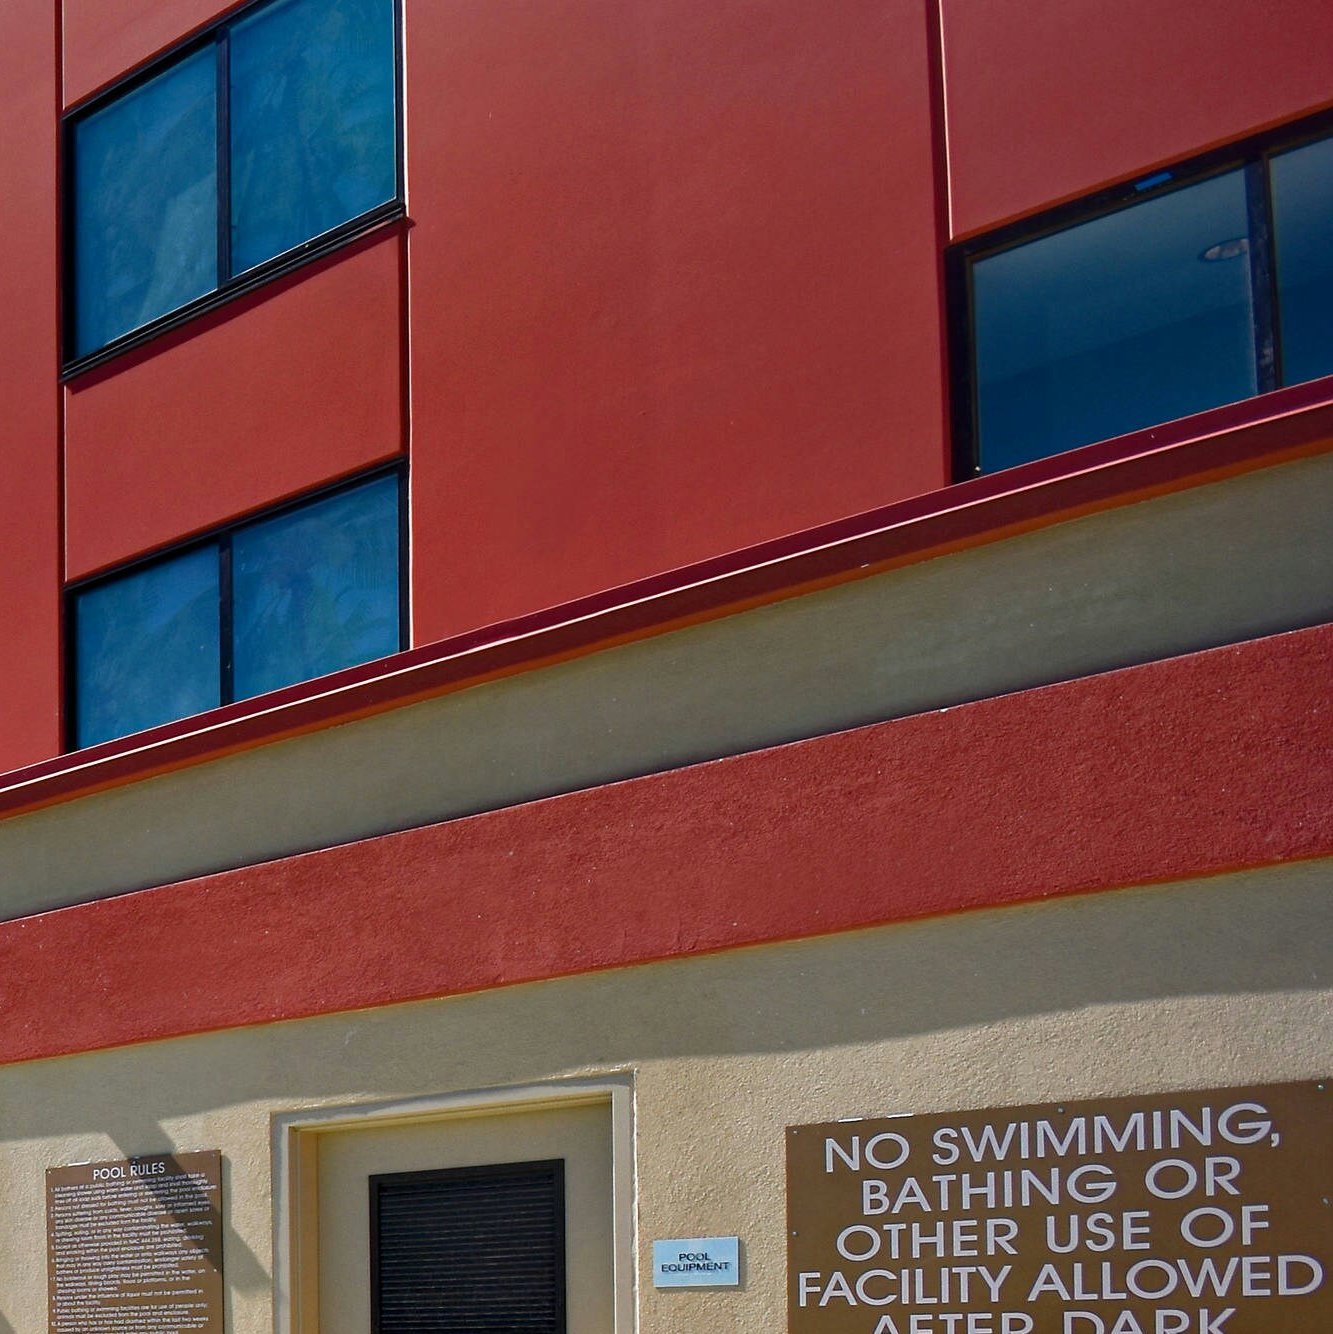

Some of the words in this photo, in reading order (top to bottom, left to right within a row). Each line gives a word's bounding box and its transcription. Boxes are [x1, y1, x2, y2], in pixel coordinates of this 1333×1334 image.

[825, 1132, 910, 1173] NO
[932, 1102, 1280, 1166] SWIMMING,
[93, 1167, 126, 1180] POOL
[130, 1162, 165, 1177] RULES
[862, 1163, 1118, 1216] BATHING
[1144, 1156, 1241, 1200] OR
[678, 1252, 712, 1262] POOL
[836, 1217, 1019, 1262] OTHER
[1046, 1210, 1151, 1254] USE
[1180, 1204, 1270, 1249] OF
[661, 1261, 729, 1273] EQUIPMENT
[798, 1264, 1012, 1308] FACILITY
[1027, 1253, 1323, 1302] ALLOWED
